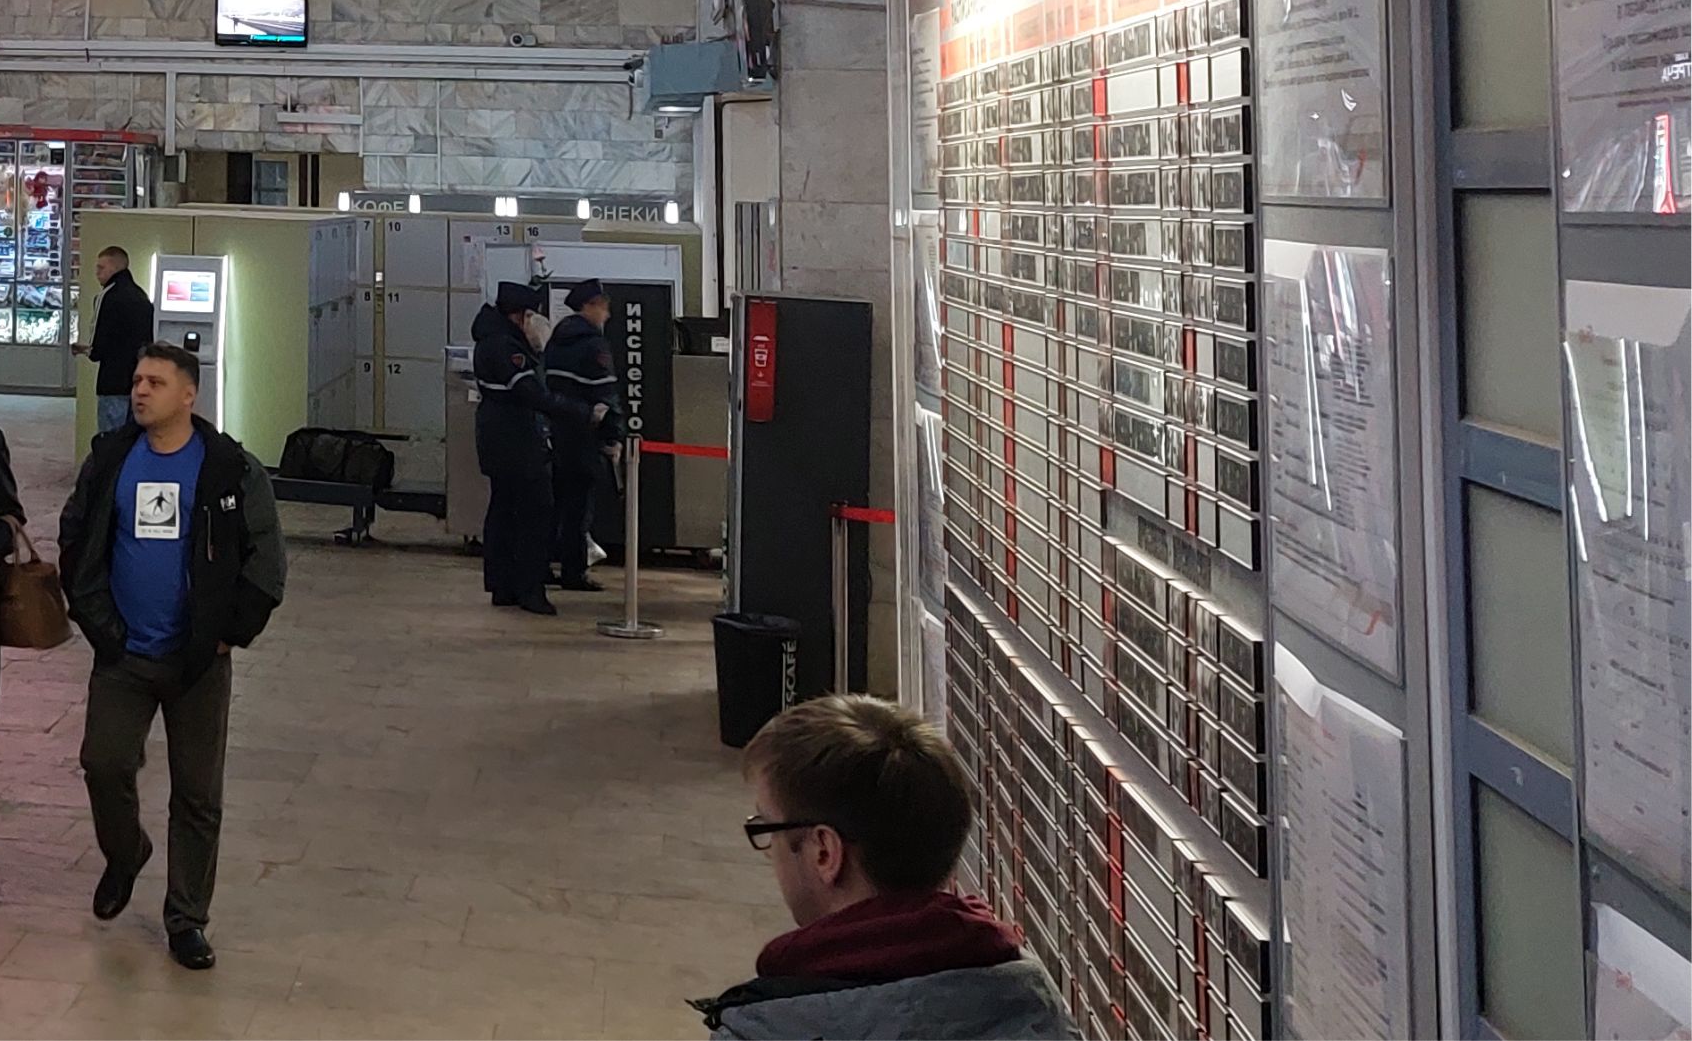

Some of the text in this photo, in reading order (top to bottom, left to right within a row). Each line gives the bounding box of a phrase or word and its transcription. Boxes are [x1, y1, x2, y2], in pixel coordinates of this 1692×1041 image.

[351, 200, 404, 211] КОФЕ
[590, 205, 660, 223] СНЕКИ
[363, 220, 370, 231] 7
[388, 221, 401, 233] 10
[497, 225, 510, 236] 13
[527, 226, 539, 237] 16
[364, 292, 371, 302] 8
[388, 293, 400, 303] 11
[364, 362, 371, 373] 9
[388, 363, 401, 374] 12
[626, 303, 643, 439] инспекто
[782, 640, 797, 711] SCAFÉ
